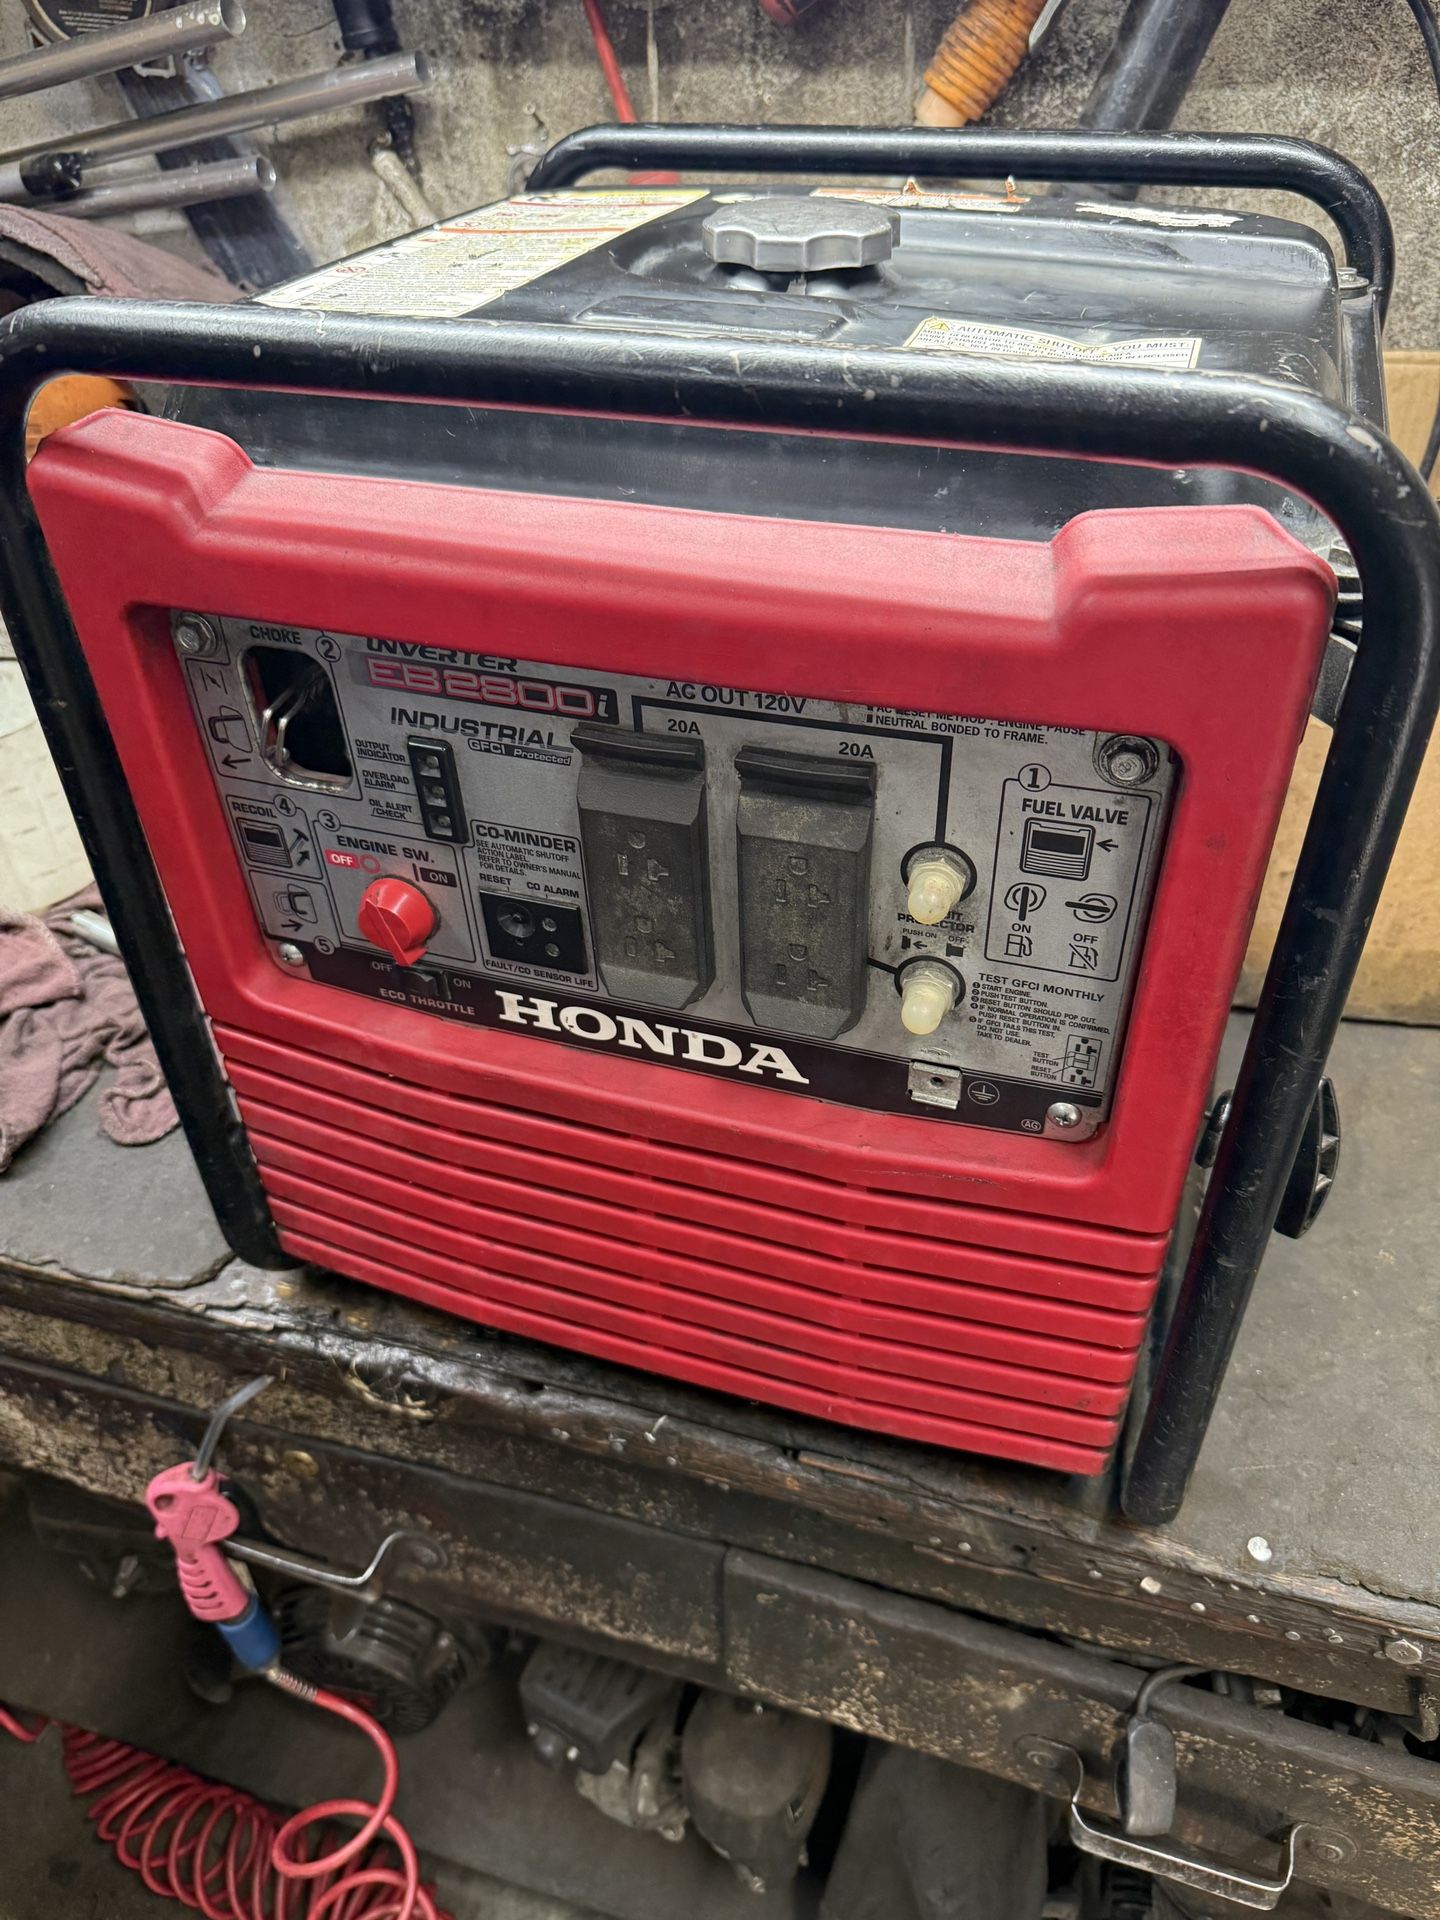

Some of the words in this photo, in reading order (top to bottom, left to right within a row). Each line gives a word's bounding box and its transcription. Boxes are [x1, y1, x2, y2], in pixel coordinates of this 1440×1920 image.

[958, 326, 1034, 341] AUTOMATIC
[1112, 343, 1141, 351] YOU
[250, 625, 302, 645] CHOKE
[321, 639, 336, 660] 2
[666, 681, 696, 700] AC
[701, 685, 750, 707] OUT
[754, 694, 807, 714] 120V
[391, 707, 574, 754] INDUSTRIAL
[667, 719, 701, 735] 20A
[876, 715, 928, 730] NEUTRAL
[931, 721, 980, 736] BONDED
[984, 727, 1000, 738] TO
[1004, 730, 1049, 744] FRAME.
[355, 739, 390, 752] OUTPUT
[469, 740, 506, 755] GFCI
[513, 748, 572, 766] Protected
[838, 742, 874, 758] 20A
[357, 747, 406, 762] INDICATOR
[362, 769, 410, 785] OVERLOAD
[364, 778, 396, 790] ALARM
[1027, 767, 1040, 788] 1
[232, 802, 277, 818] RECOIL
[280, 798, 291, 814] 4
[368, 798, 384, 808] OIL
[386, 801, 412, 813] ALERT
[1022, 798, 1066, 817] FUEL
[1071, 804, 1129, 825] VALVE
[322, 812, 336, 829] 3
[372, 808, 406, 820] /CHECK
[475, 824, 576, 853] CO-MINDER
[336, 834, 398, 856] ENGINE
[402, 847, 435, 863] SW.
[476, 839, 490, 849] SEE
[491, 842, 535, 857] AUTOMATIC
[535, 850, 569, 863] SHUTOFF
[477, 847, 505, 859] ACTION
[331, 853, 353, 866] OFF
[478, 854, 501, 865] REFER
[502, 858, 512, 867] TO
[513, 861, 548, 874] OWNER'S
[548, 867, 582, 880] MANUAL
[480, 861, 495, 871] FOR
[429, 872, 449, 884] ON
[480, 872, 512, 886] RESET
[526, 881, 541, 891] CO
[543, 885, 580, 899] ALARM
[902, 927, 924, 936] PUSH
[924, 931, 937, 939] ON
[1011, 922, 1032, 934] ON
[317, 938, 330, 952] 5
[948, 935, 965, 943] OFF
[1073, 933, 1098, 944] OFF
[371, 960, 393, 973] OFF
[485, 960, 531, 975] FAULT/CO
[533, 969, 573, 983] SENSOR
[574, 976, 594, 988] LIFE
[453, 978, 472, 989] ON
[979, 972, 1009, 985] TEST
[1011, 978, 1040, 991] GFCI
[1042, 984, 1105, 1002] MONTHLY
[981, 983, 1003, 992] START
[379, 988, 406, 1001] ECO
[410, 994, 475, 1016] THROTTLE
[980, 990, 1000, 999] PUSH
[1000, 994, 1017, 1002] TEST
[980, 997, 1001, 1006] RESET
[1003, 1001, 1032, 1012] BUTTON
[1033, 1007, 1062, 1018] SHOULD
[1064, 1012, 1078, 1020] POP
[987, 1006, 1017, 1016] NORMAL
[1019, 1012, 1057, 1024] OPERATION
[978, 1011, 997, 1019] PUSH
[999, 1014, 1020, 1023] RESET
[1022, 1018, 1050, 1030] BUTTON
[986, 1019, 1001, 1027] GFCI
[1002, 1022, 1021, 1031] FAILS
[1022, 1026, 1038, 1034] THIS
[495, 990, 810, 1084] HONDA
[976, 1031, 993, 1039] TAKE
[1031, 1064, 1052, 1074] RESET
[1032, 1057, 1059, 1067] BUTTON
[1030, 1070, 1057, 1080] BUTTON
[1024, 1120, 1039, 1130] AG
